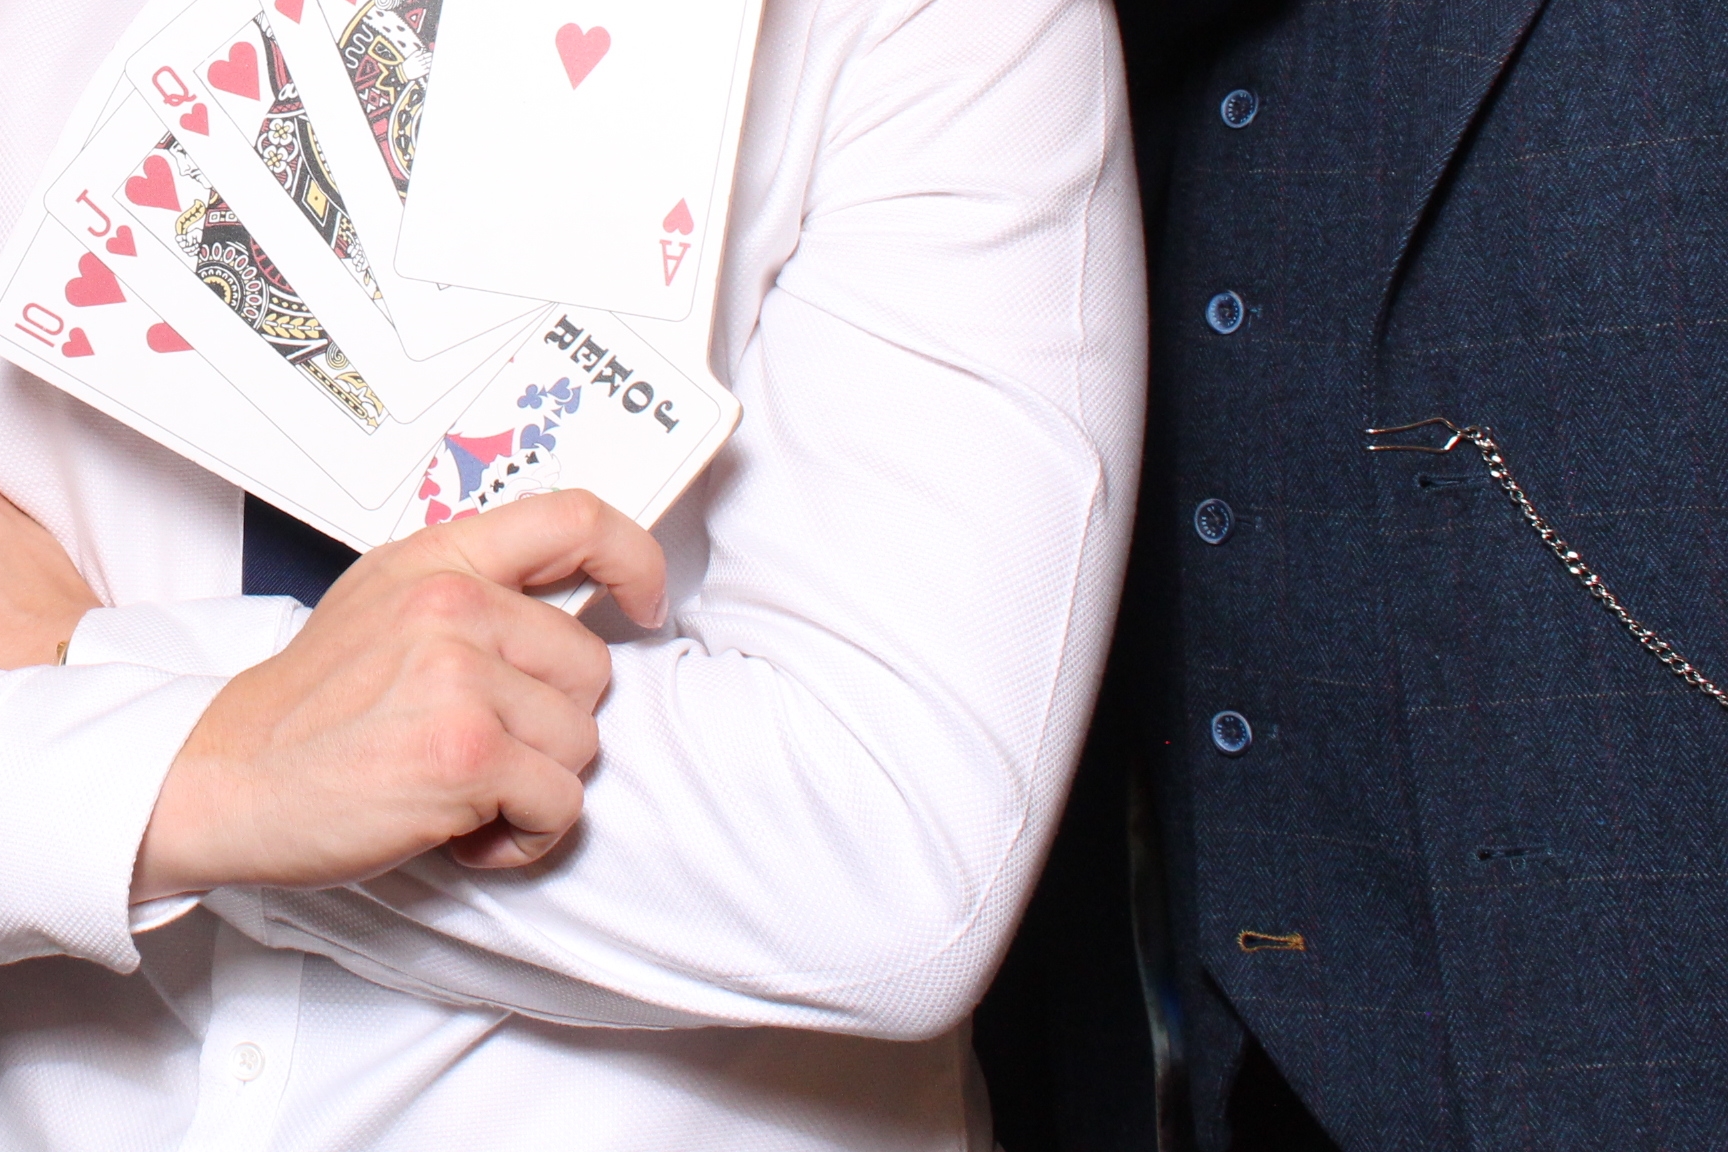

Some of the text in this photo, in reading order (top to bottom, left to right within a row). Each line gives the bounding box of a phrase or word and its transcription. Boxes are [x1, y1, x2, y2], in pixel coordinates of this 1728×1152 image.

[151, 65, 198, 106] Q
[75, 189, 112, 238] J
[658, 239, 691, 287] A
[14, 302, 65, 348] 10
[543, 314, 680, 434] JOKER
